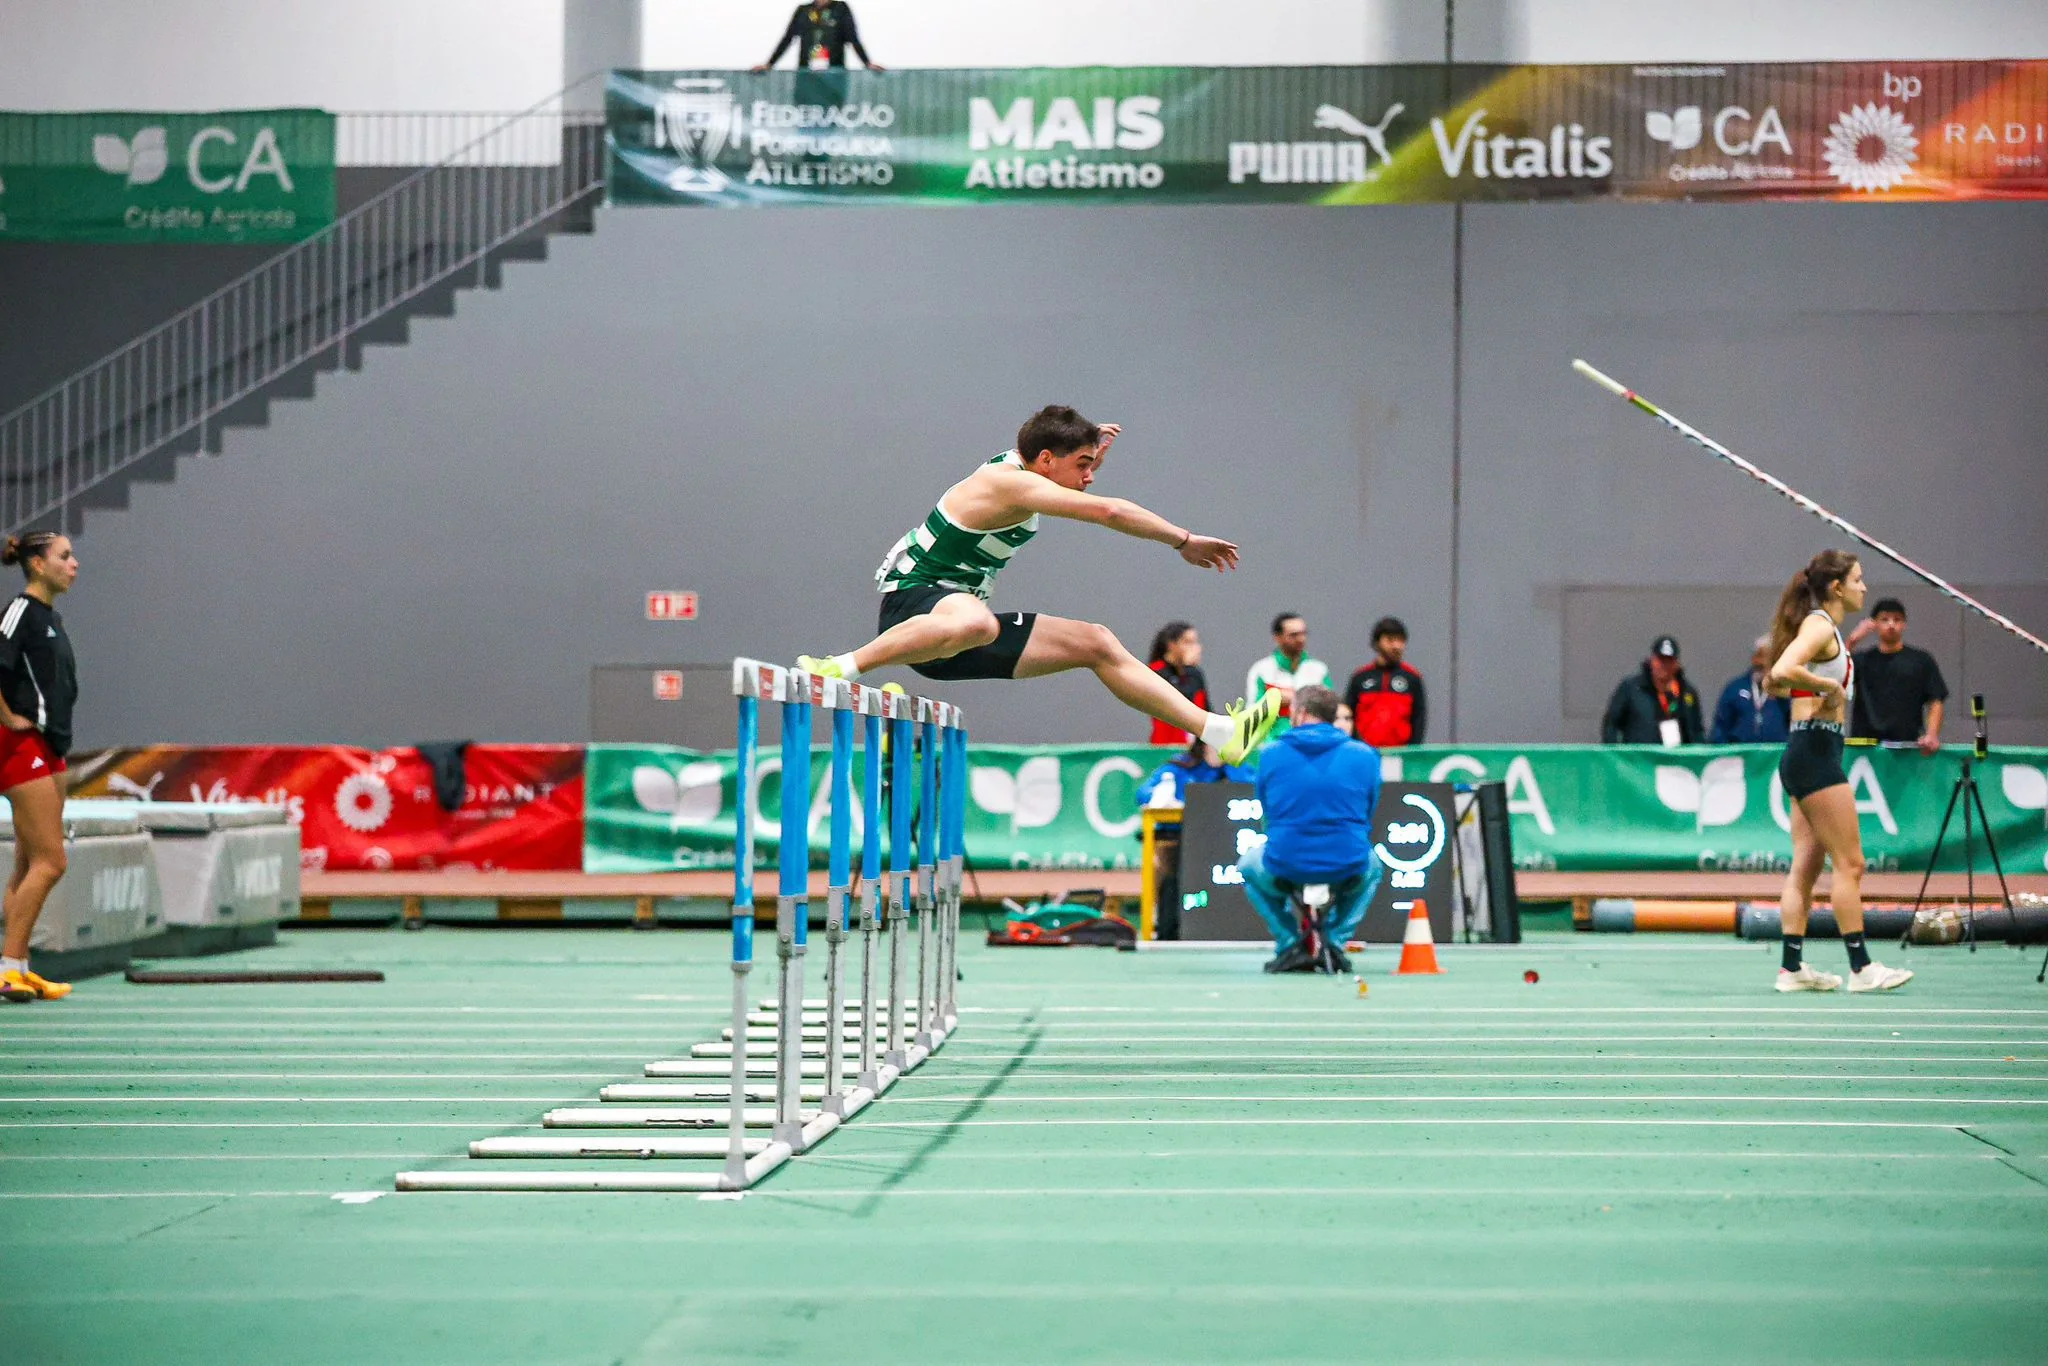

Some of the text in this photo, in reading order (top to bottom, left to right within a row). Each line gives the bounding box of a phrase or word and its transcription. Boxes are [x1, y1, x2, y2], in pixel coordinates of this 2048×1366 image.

[1884, 72, 1922, 102] bp
[968, 95, 1165, 151] MAIS
[1429, 107, 1614, 179] Vitalis
[1713, 105, 1793, 157] CA
[187, 126, 295, 193] CA
[965, 155, 1165, 189] Atletismo
